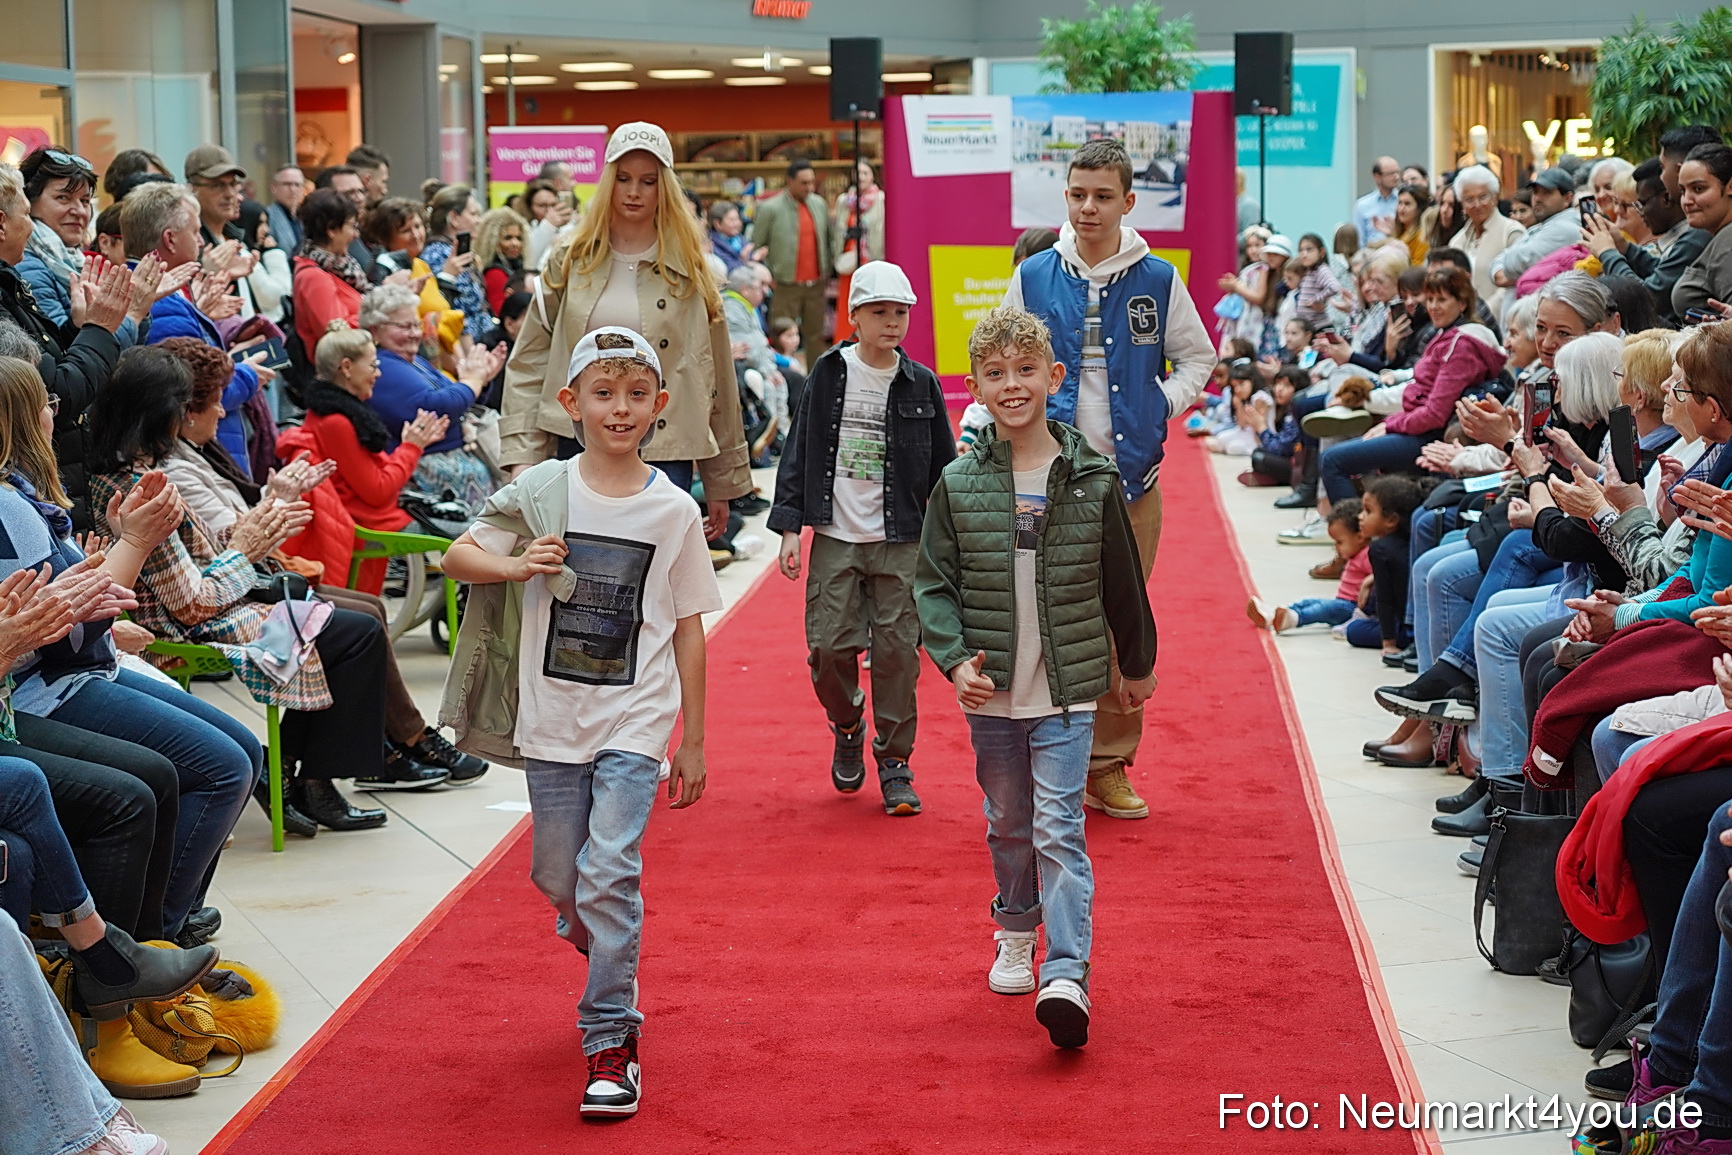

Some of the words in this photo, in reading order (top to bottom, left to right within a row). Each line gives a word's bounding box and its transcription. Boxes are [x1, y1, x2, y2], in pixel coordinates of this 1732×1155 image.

[621, 131, 660, 145] JOOP!
[496, 146, 573, 161] Verschenken
[574, 145, 596, 160] Sie
[963, 277, 980, 290] Du
[953, 292, 995, 306] Schuhe
[1126, 294, 1159, 337] G
